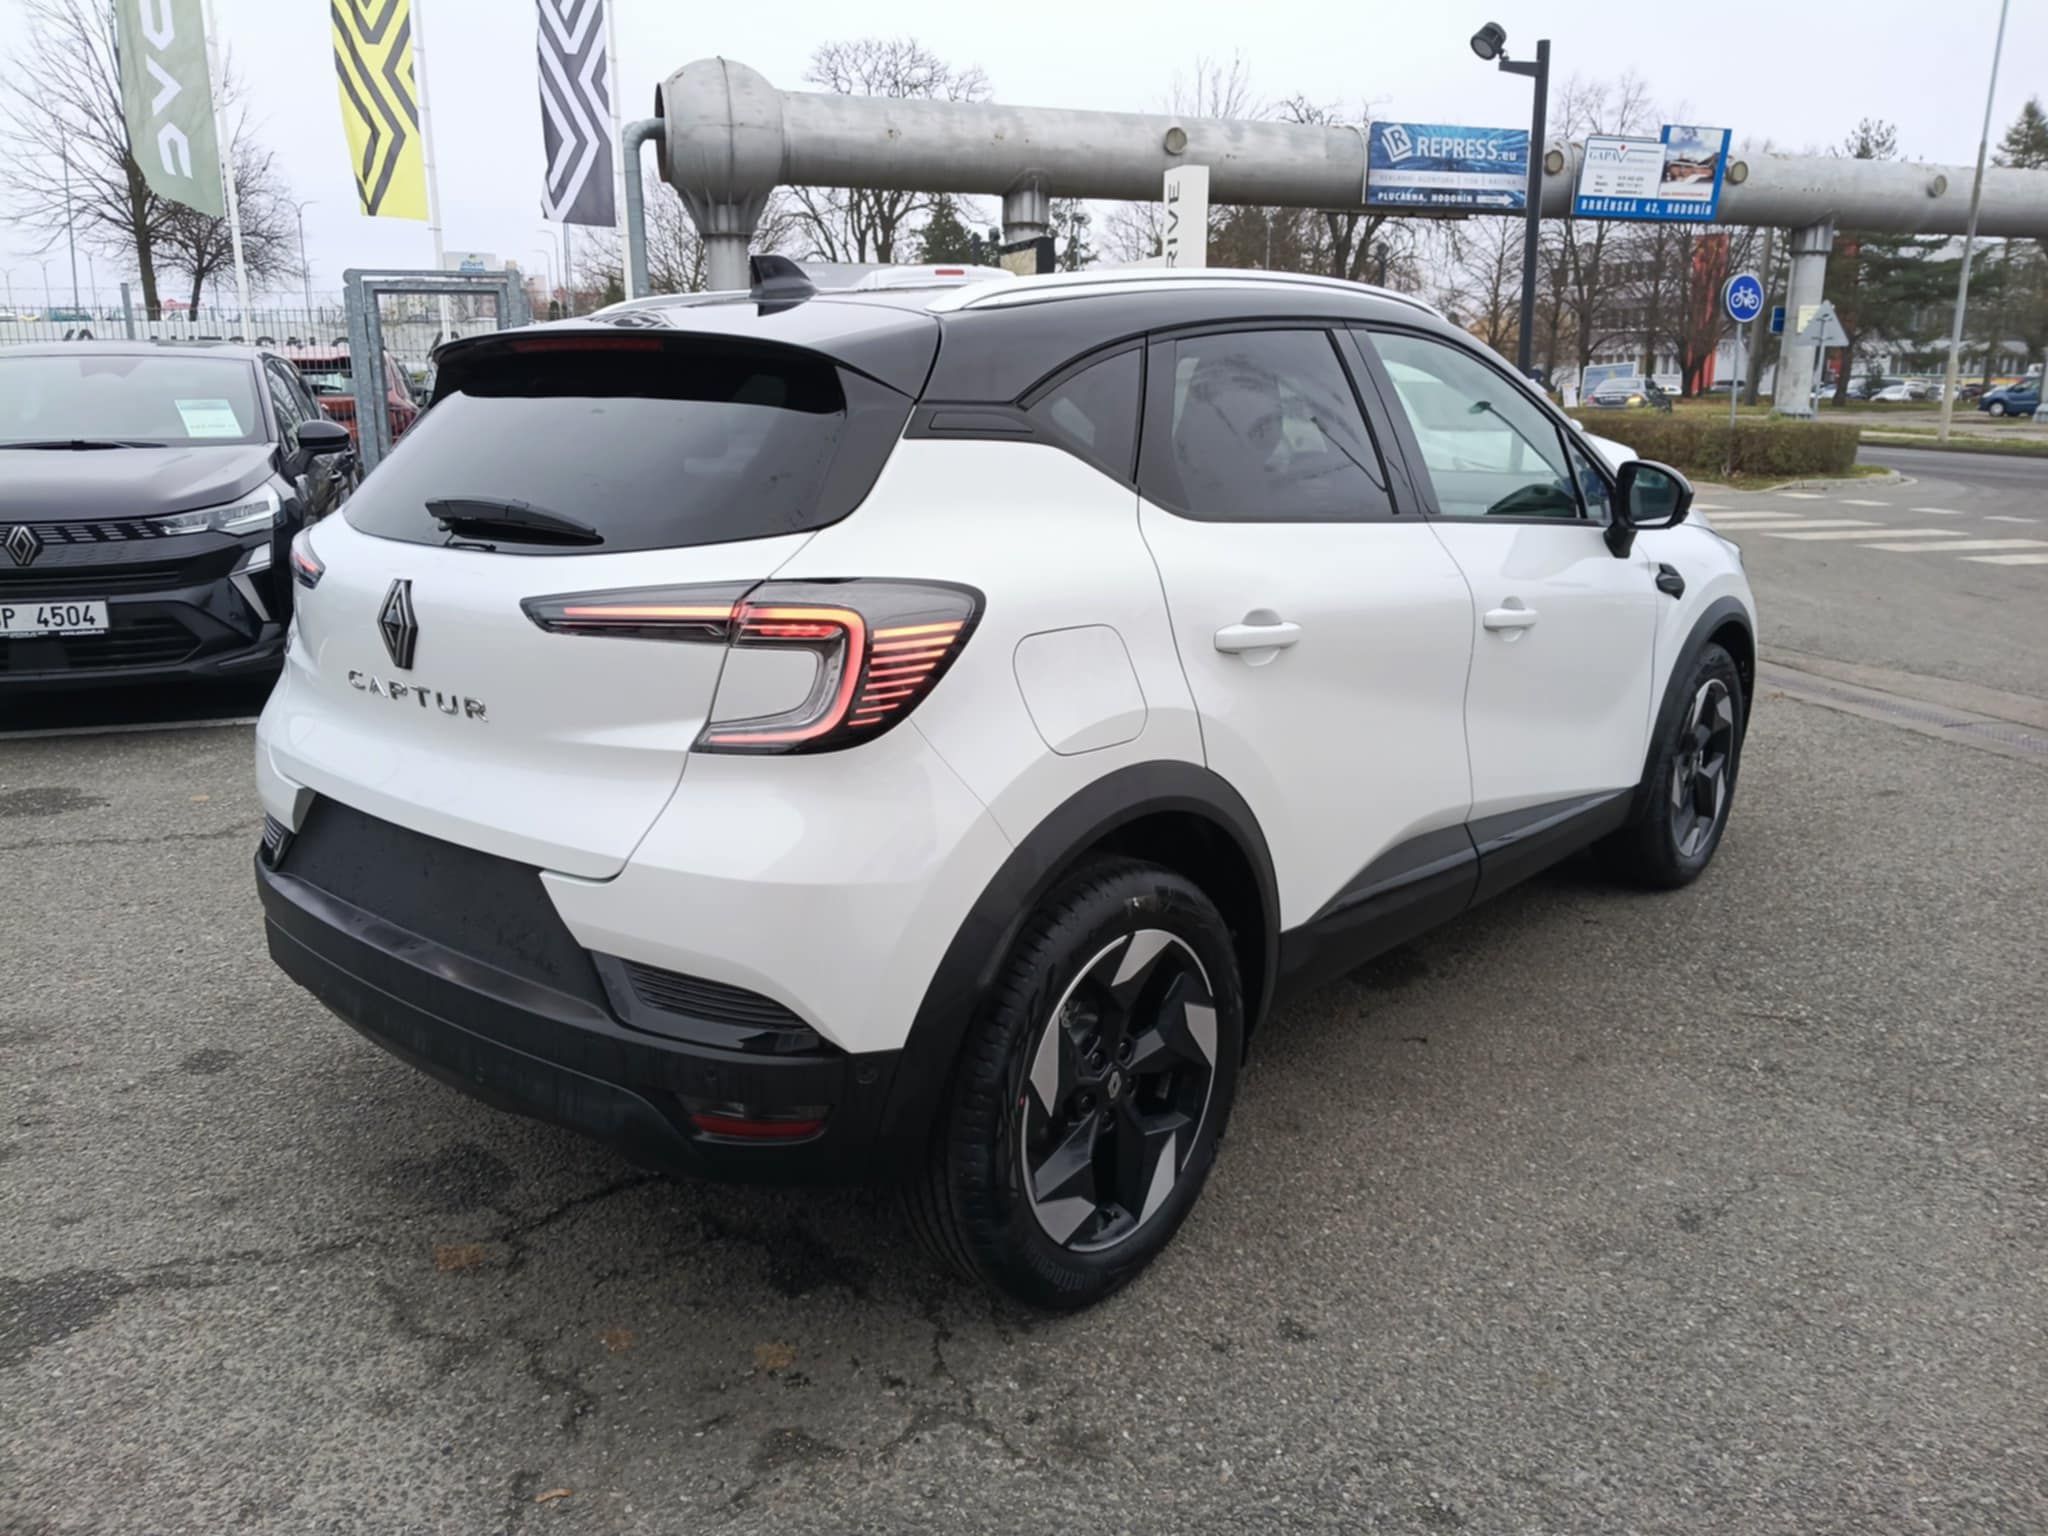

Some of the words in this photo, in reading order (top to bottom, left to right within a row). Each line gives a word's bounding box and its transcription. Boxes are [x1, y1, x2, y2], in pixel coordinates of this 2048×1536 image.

[1416, 136, 1517, 161] REPRESS.eu
[0, 608, 15, 629] P
[36, 604, 96, 628] 4504
[348, 670, 489, 722] CAPTUR
